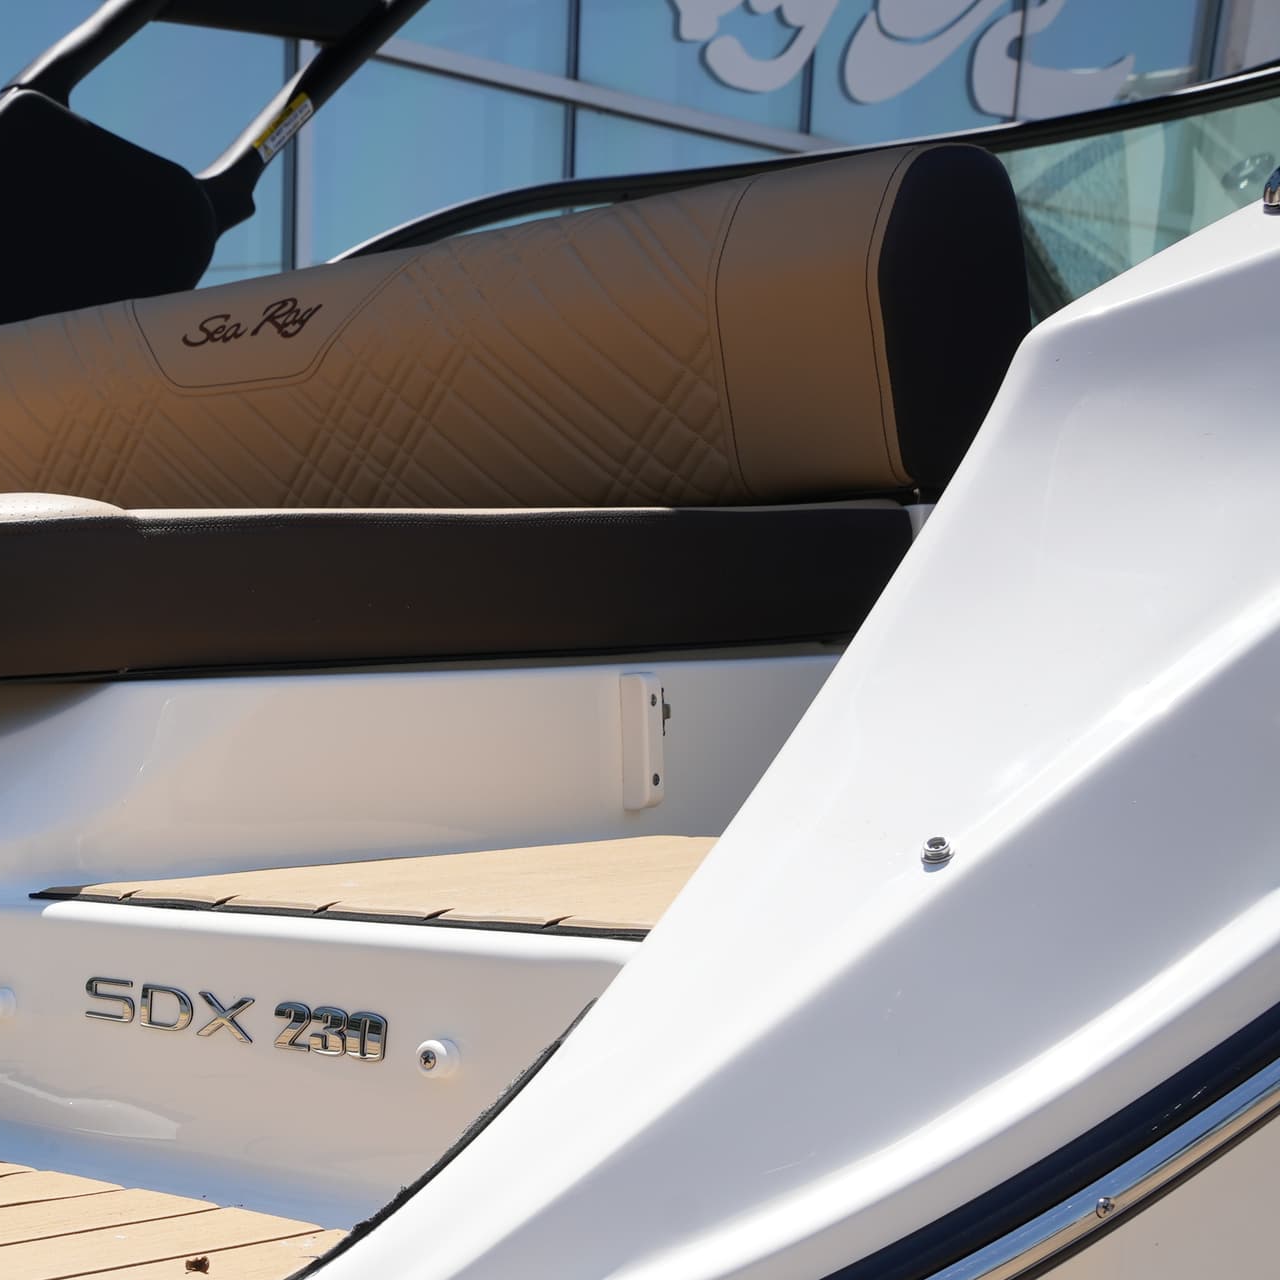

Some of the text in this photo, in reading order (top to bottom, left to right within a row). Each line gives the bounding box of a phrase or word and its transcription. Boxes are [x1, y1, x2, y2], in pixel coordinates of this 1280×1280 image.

[182, 297, 323, 347] Sea Ray
[84, 976, 389, 1063] SDX 230
